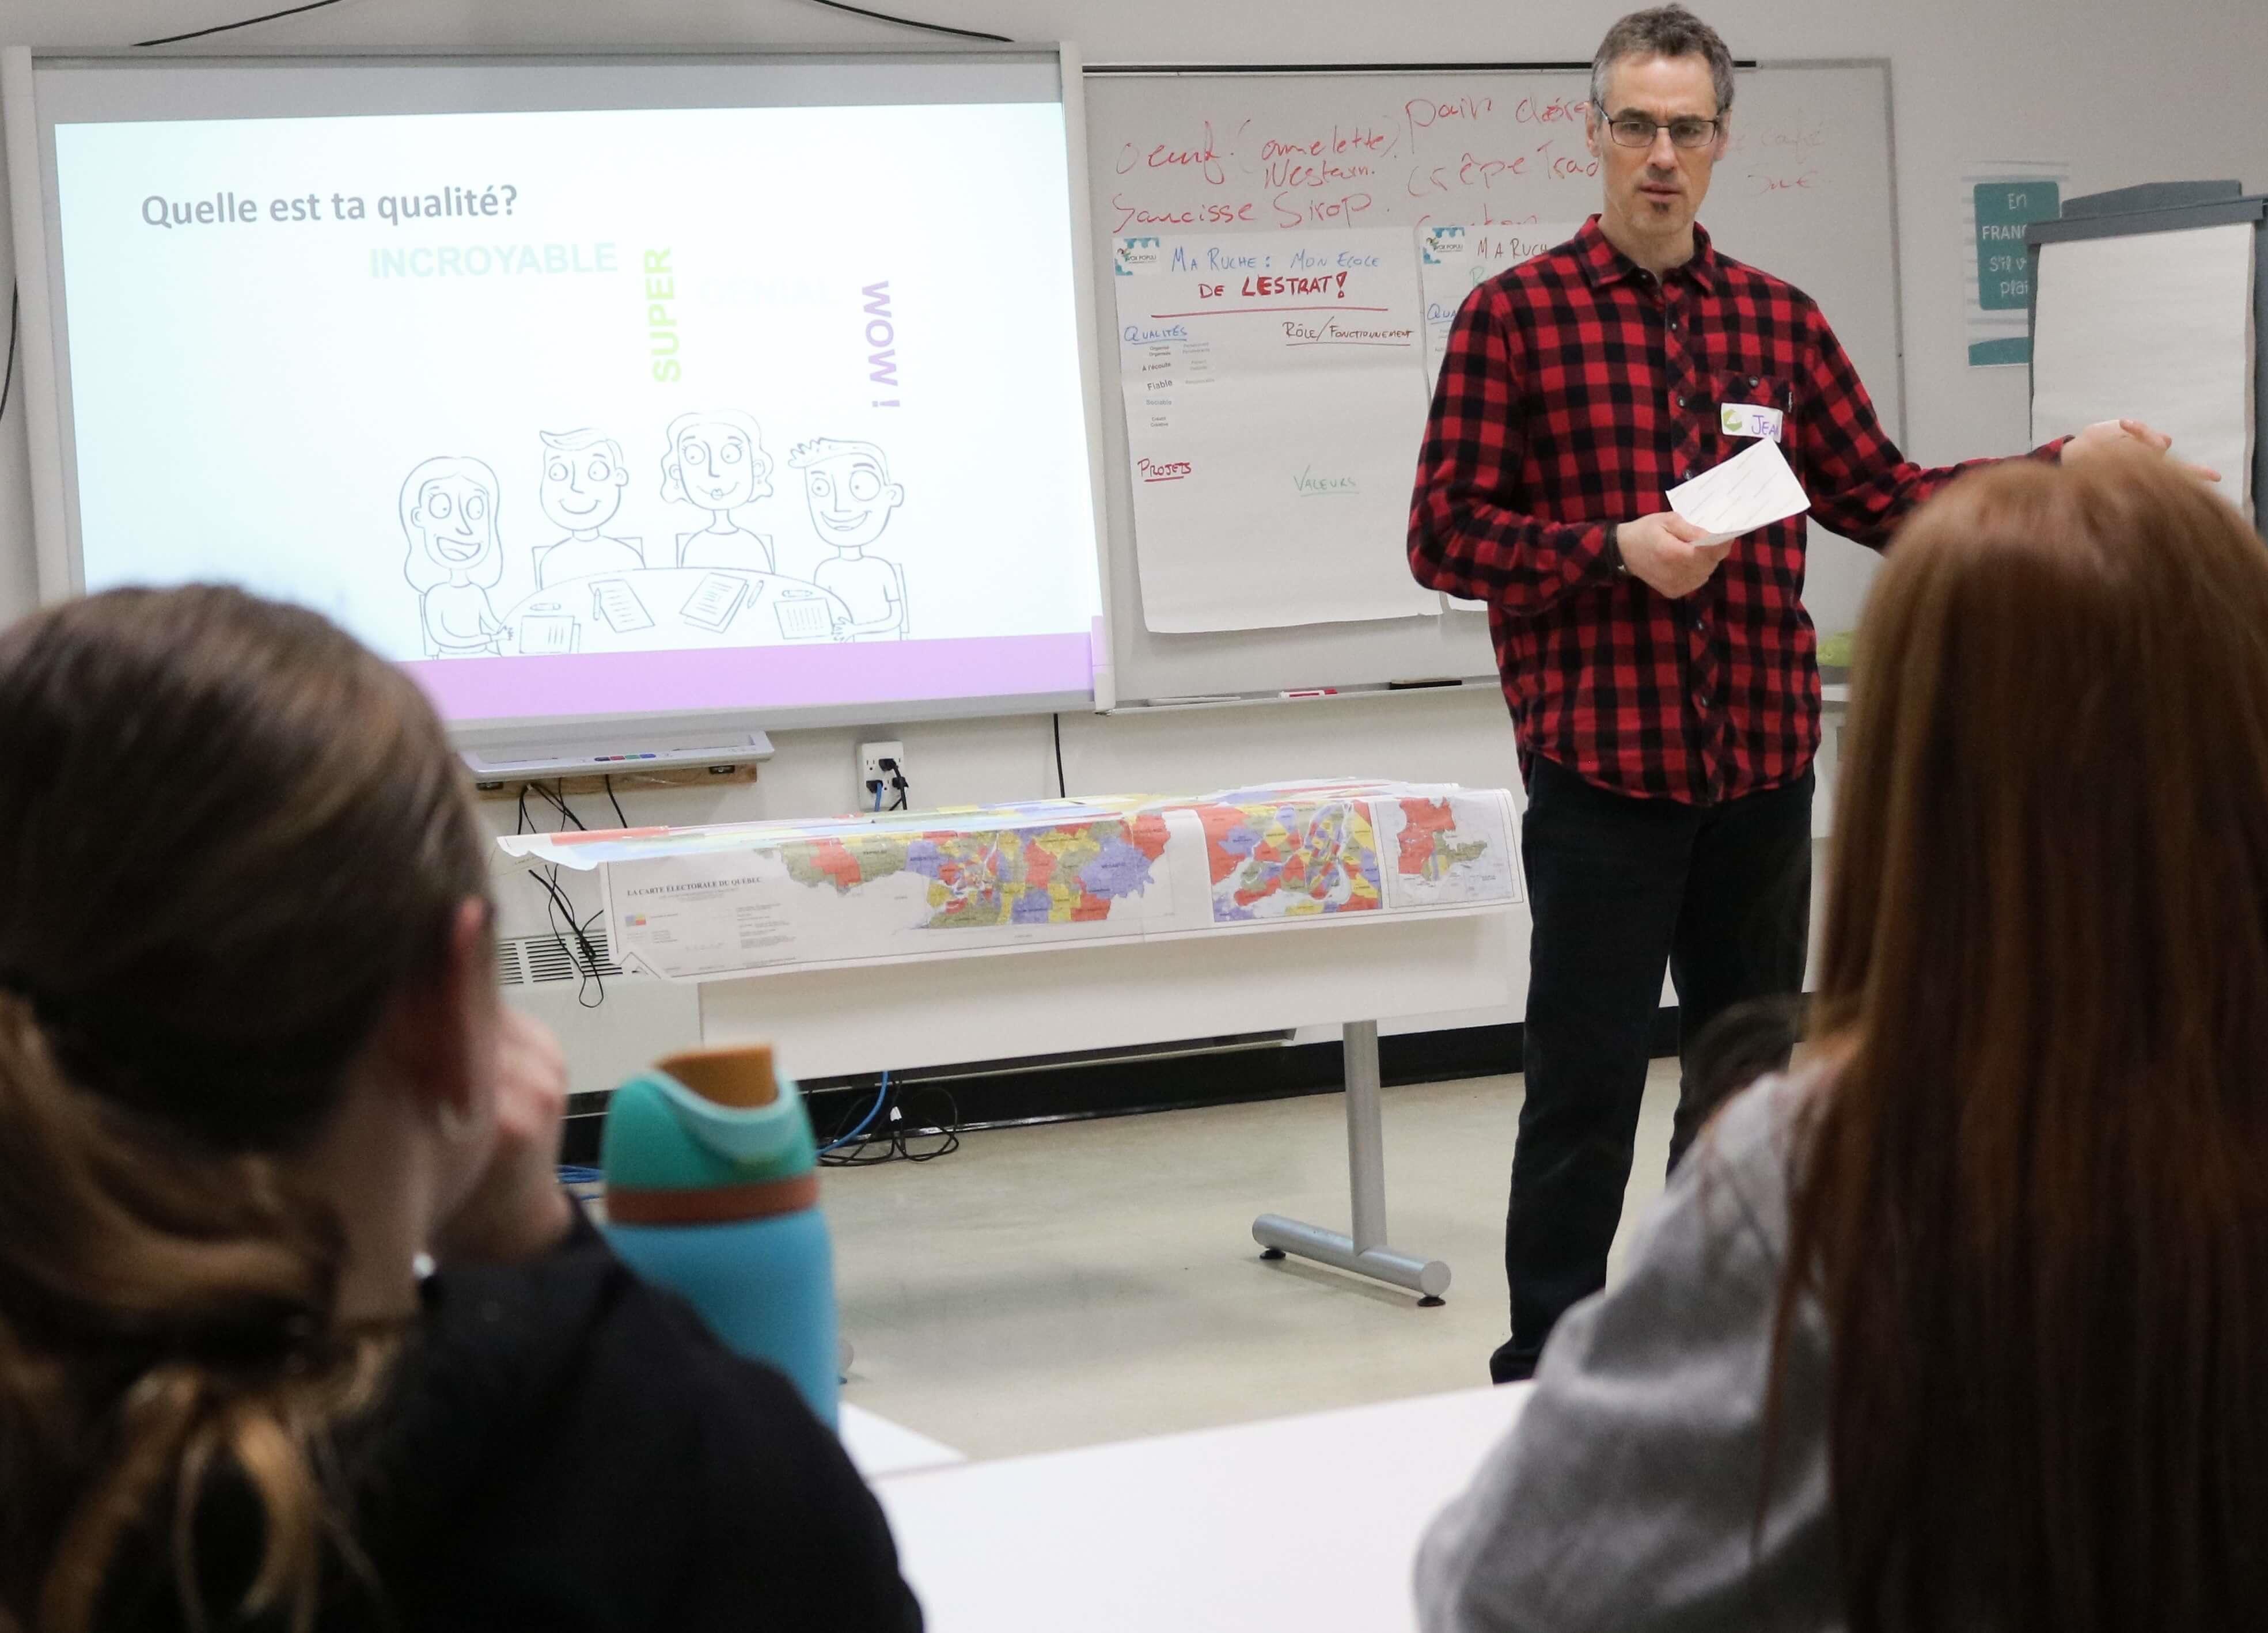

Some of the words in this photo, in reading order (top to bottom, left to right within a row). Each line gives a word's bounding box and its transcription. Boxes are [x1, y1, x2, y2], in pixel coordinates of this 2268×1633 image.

[141, 192, 257, 229] Quelle
[269, 193, 321, 222] est
[332, 192, 366, 220] ta
[377, 184, 518, 226] qualité?
[2008, 193, 2027, 210] En
[1982, 225, 2027, 241] FRAN
[1510, 238, 1548, 259] RUCH
[370, 242, 619, 279] INCROYABLE
[1207, 247, 1257, 271] RUCHE
[1198, 283, 1225, 299] DE
[643, 246, 681, 383] SUPER
[1147, 378, 1173, 391] Fiable
[639, 886, 665, 896] CARTE
[719, 879, 730, 887] DU
